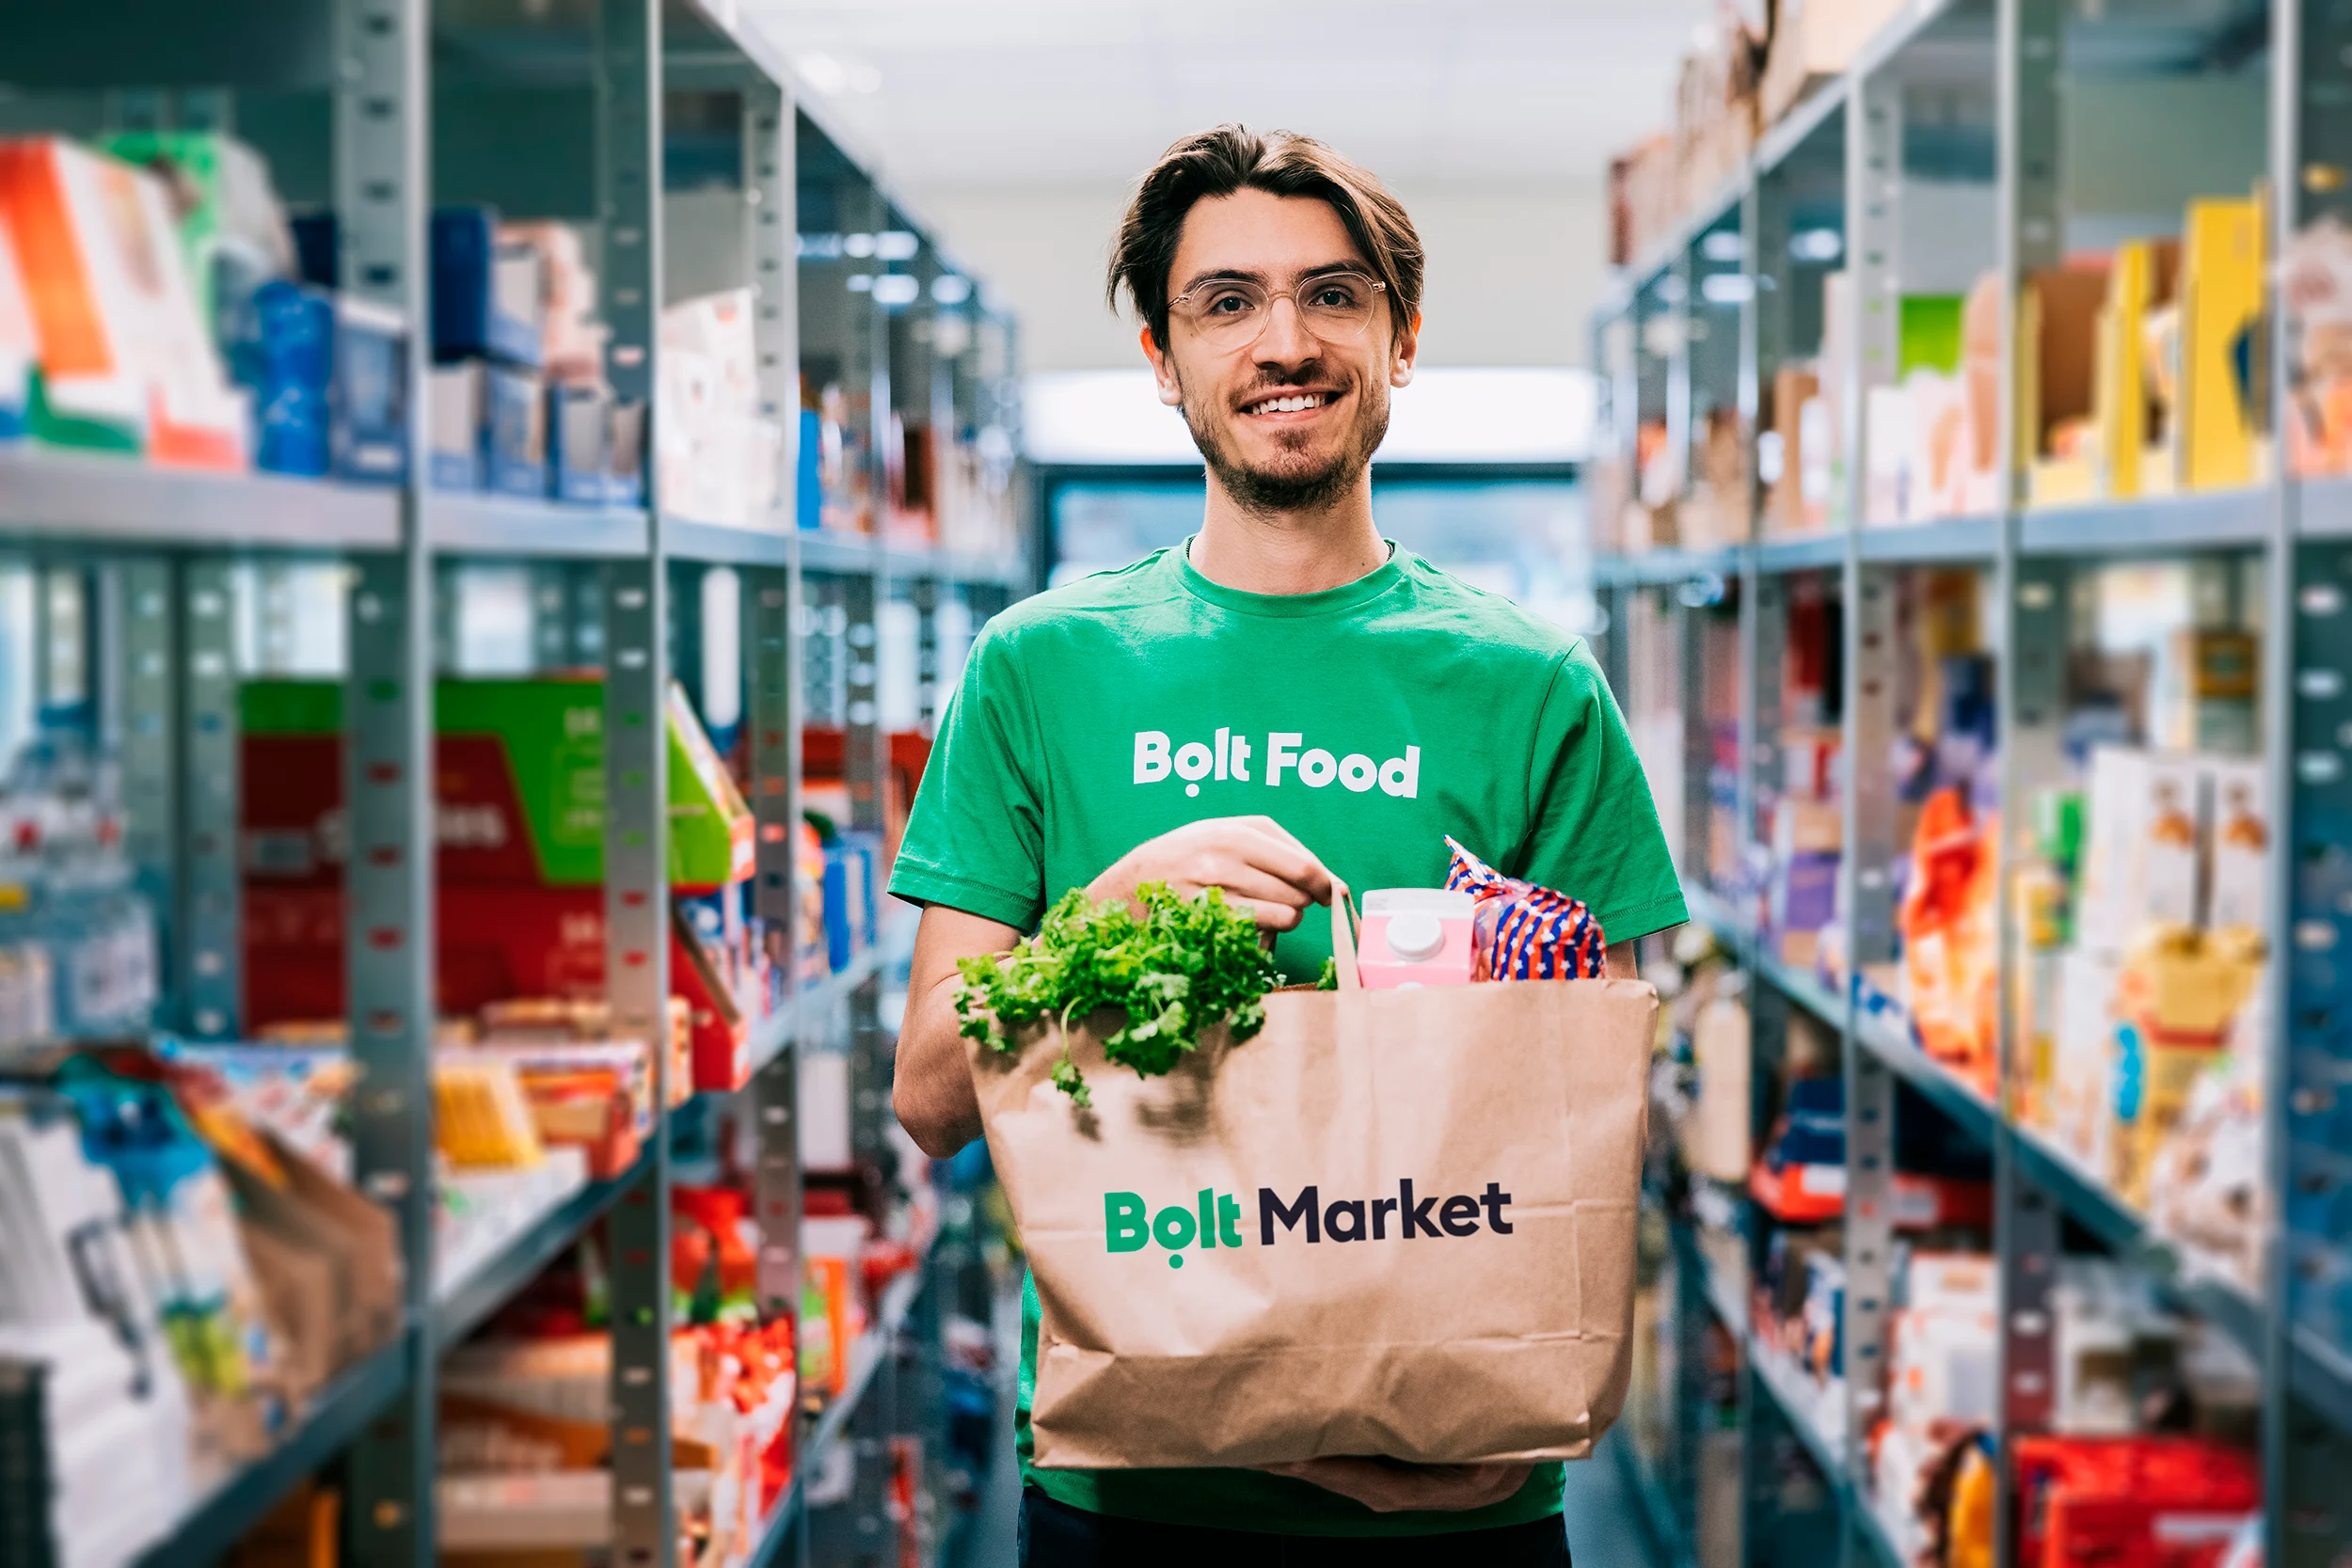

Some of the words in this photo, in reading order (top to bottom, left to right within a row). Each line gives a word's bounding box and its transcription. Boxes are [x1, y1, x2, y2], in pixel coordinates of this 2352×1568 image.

[1133, 726, 1251, 798] Bolt
[1265, 732, 1421, 799] Food
[1104, 1187, 1243, 1270] Bolt
[1258, 1178, 1514, 1246] Market
